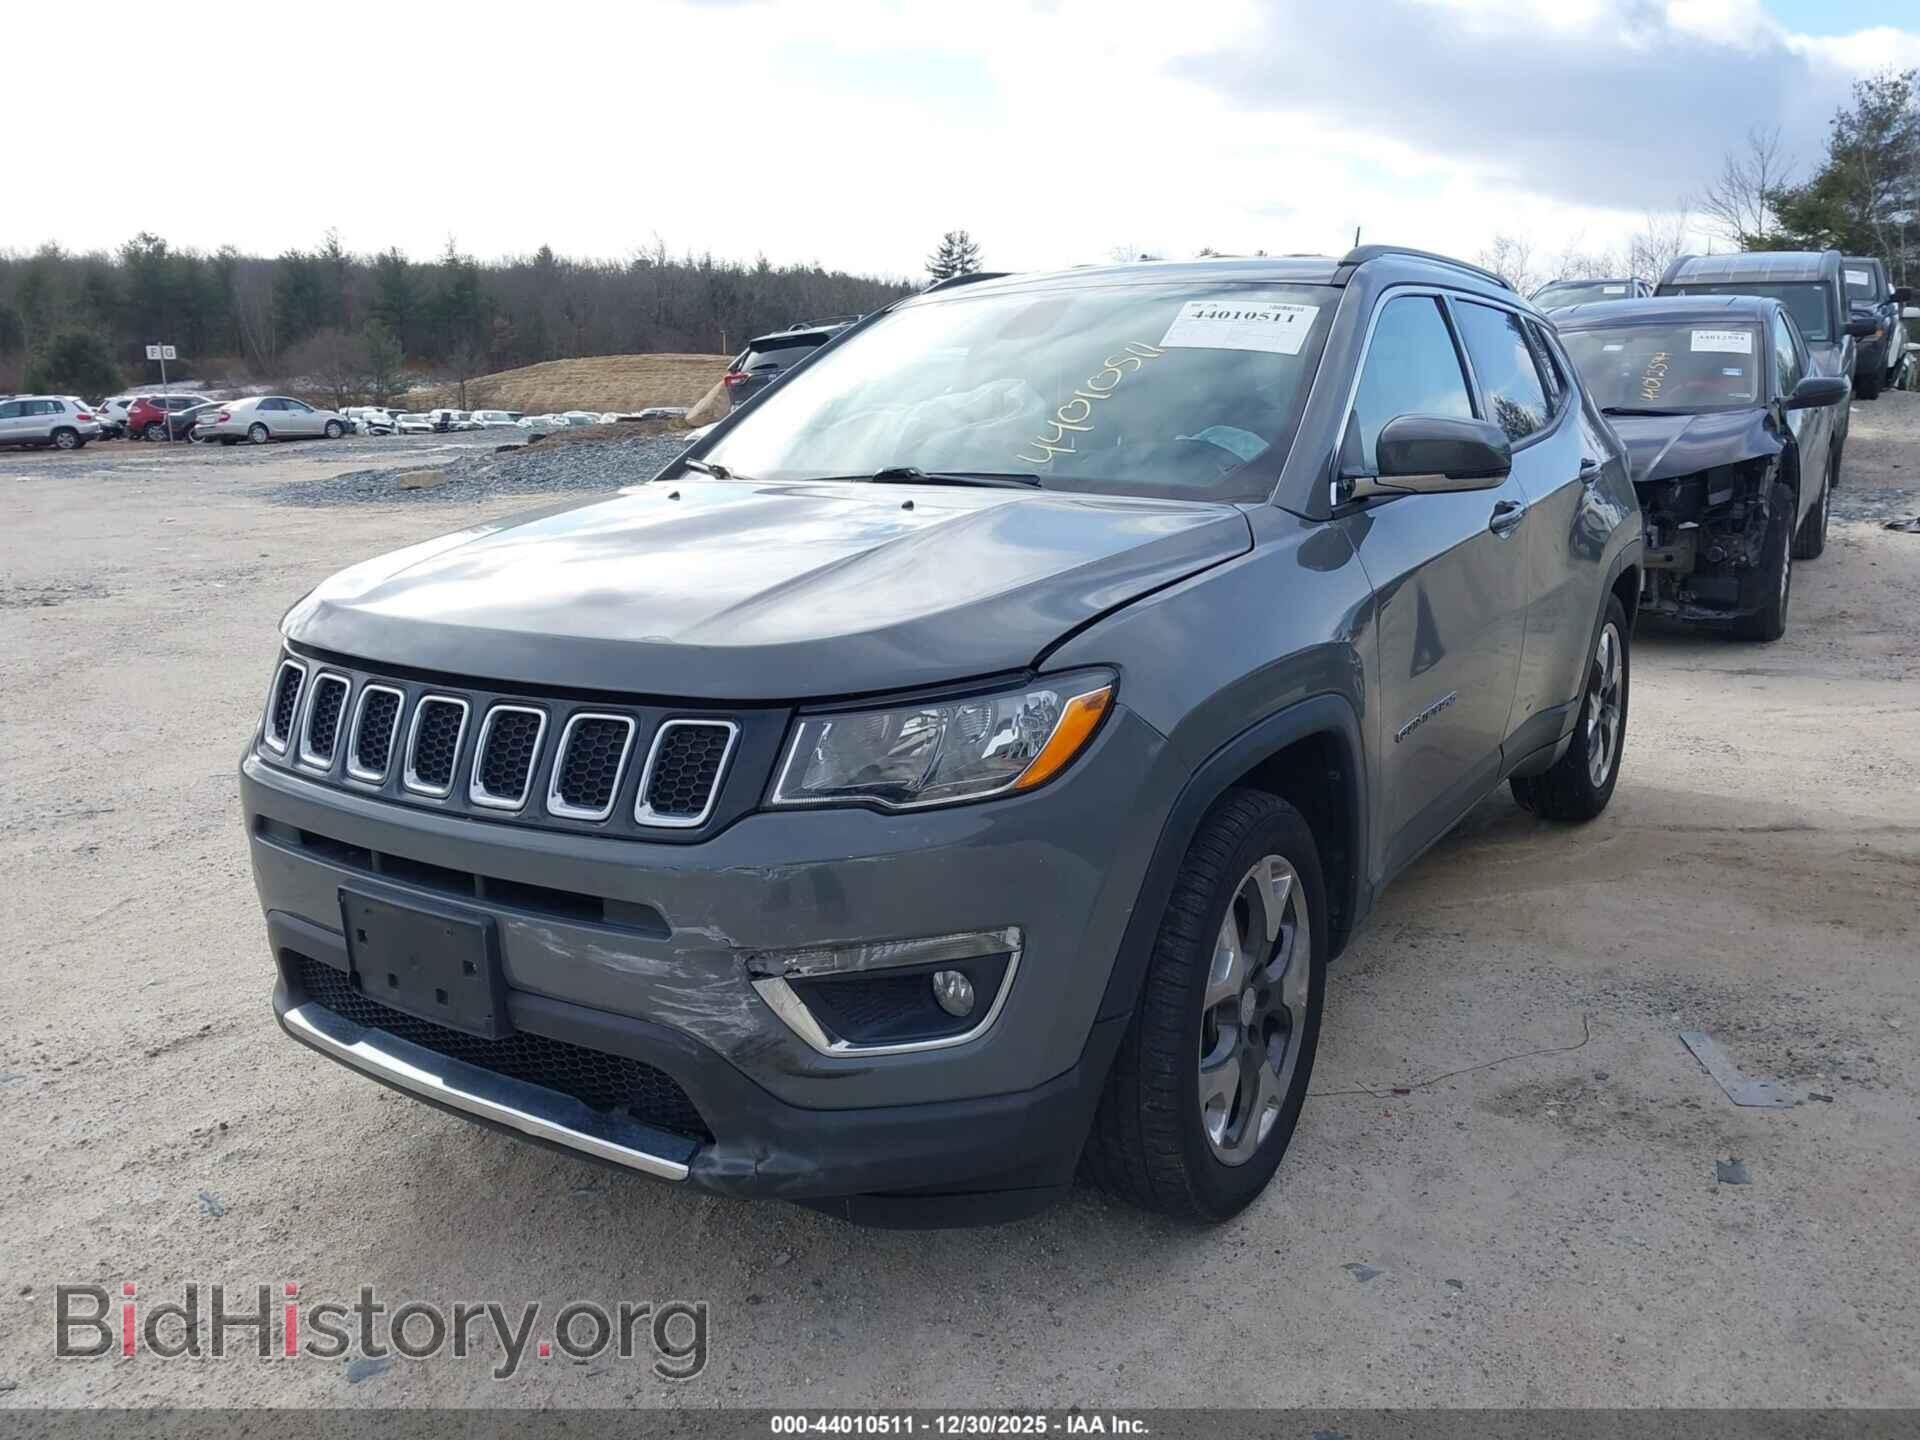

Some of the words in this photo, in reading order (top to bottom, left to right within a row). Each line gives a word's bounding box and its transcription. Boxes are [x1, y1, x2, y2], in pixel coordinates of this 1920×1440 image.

[1191, 309, 1296, 323] 44010511
[150, 347, 157, 358] F
[165, 347, 174, 358] G
[1016, 341, 1167, 464] 44010511
